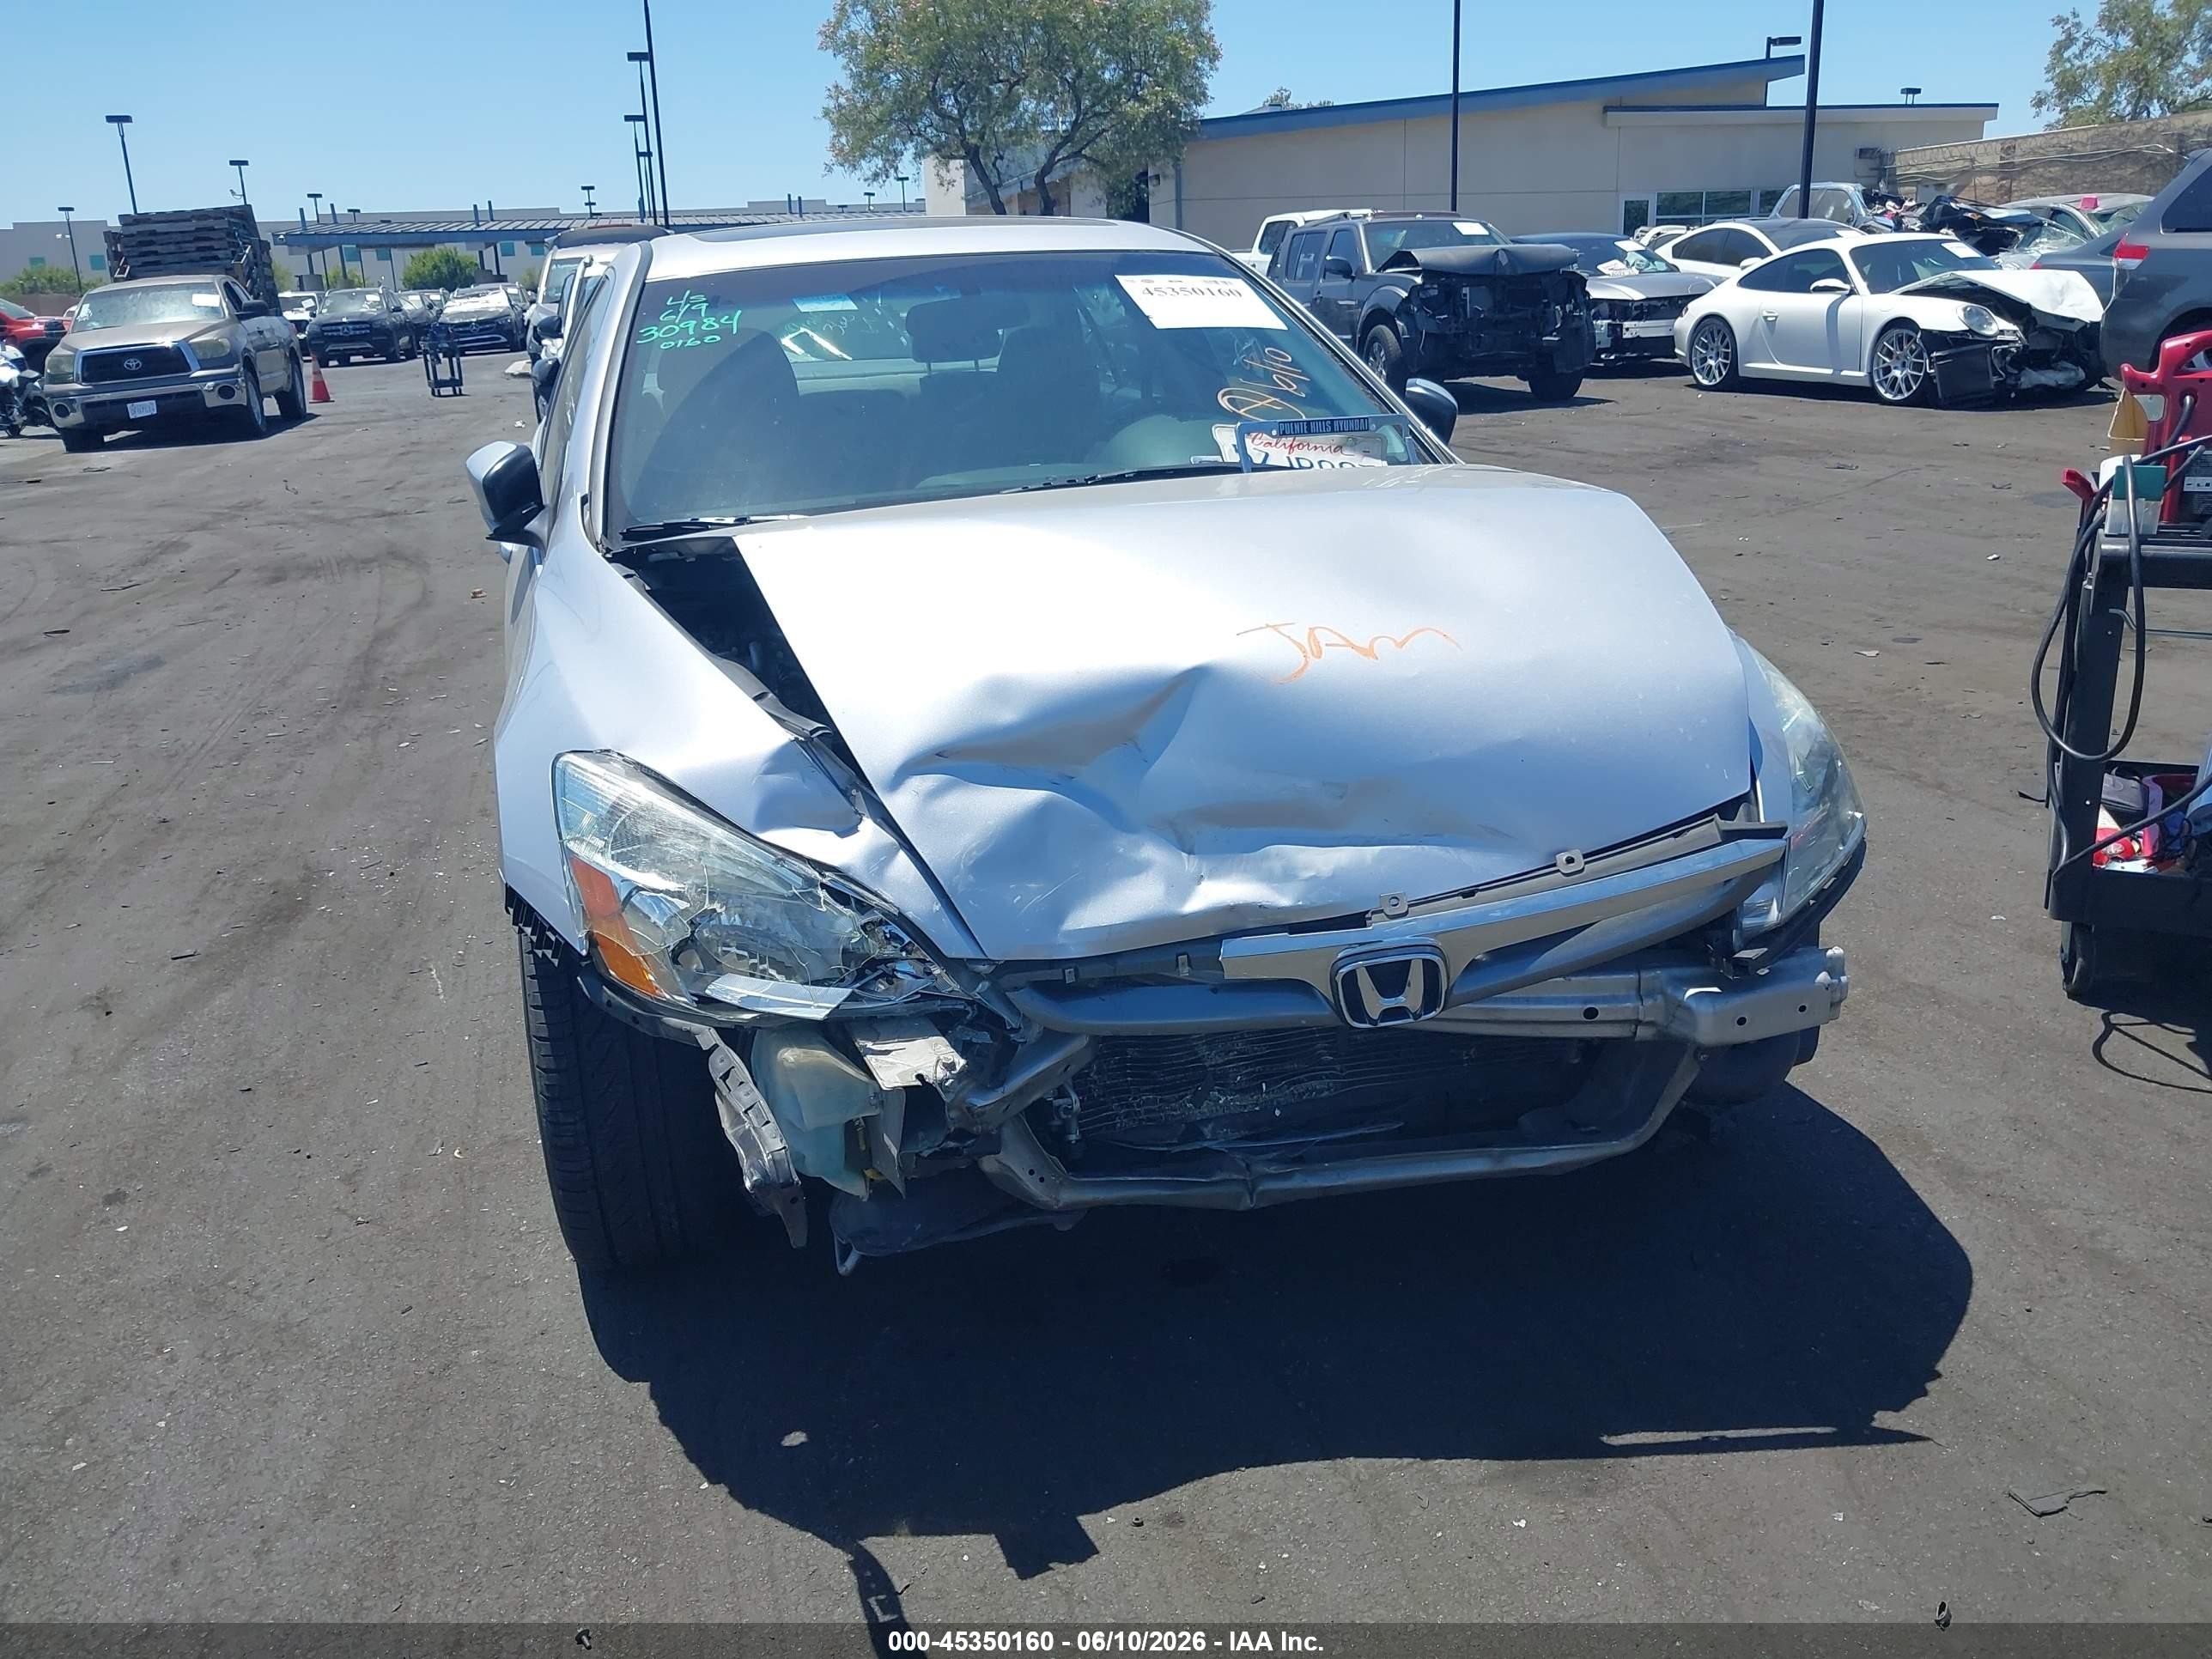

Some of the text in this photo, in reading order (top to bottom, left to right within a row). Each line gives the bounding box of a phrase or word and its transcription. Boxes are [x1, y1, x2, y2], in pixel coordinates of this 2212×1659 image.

[1142, 286, 1243, 299] 45350160
[636, 309, 742, 343] 30984
[660, 335, 721, 349] 0160
[1279, 417, 1369, 434] PUENTE HILLS HYUNDAI
[1250, 432, 1355, 457] California
